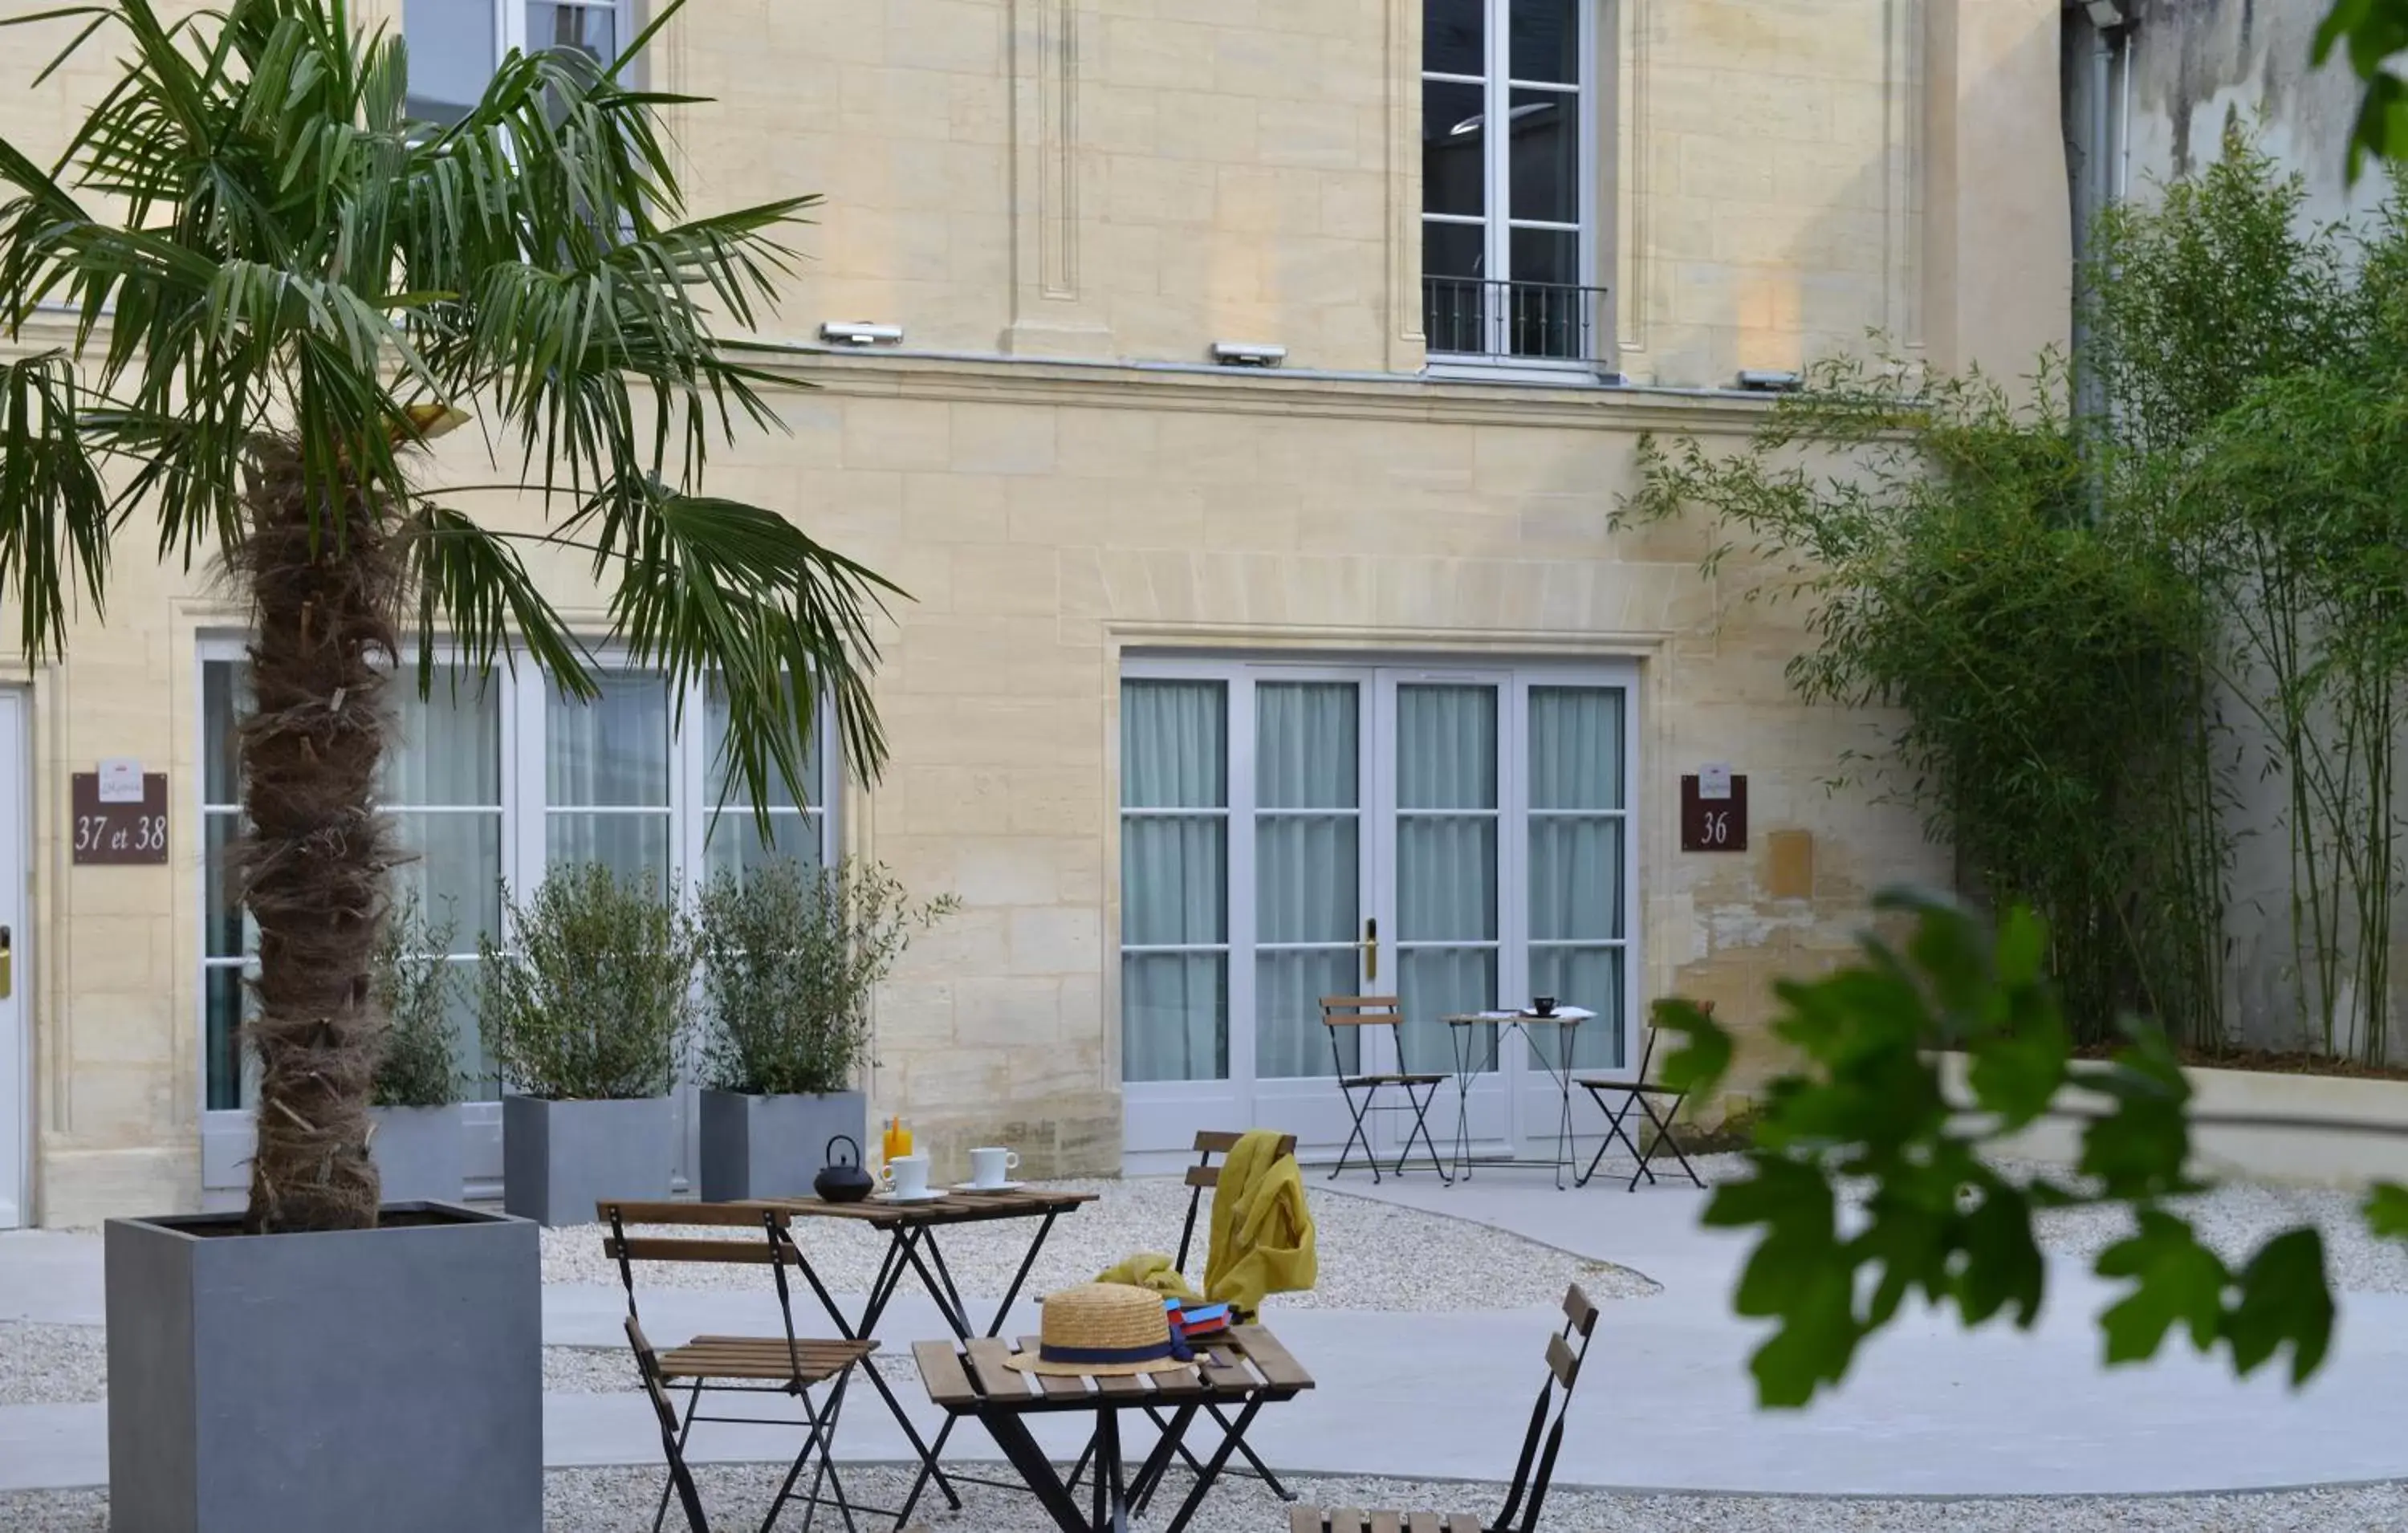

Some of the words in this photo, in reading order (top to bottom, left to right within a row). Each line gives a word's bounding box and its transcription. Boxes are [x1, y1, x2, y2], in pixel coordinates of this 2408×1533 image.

[75, 815, 108, 850] 37
[112, 827, 128, 850] et
[135, 815, 165, 850] 38
[1701, 811, 1729, 844] 36
